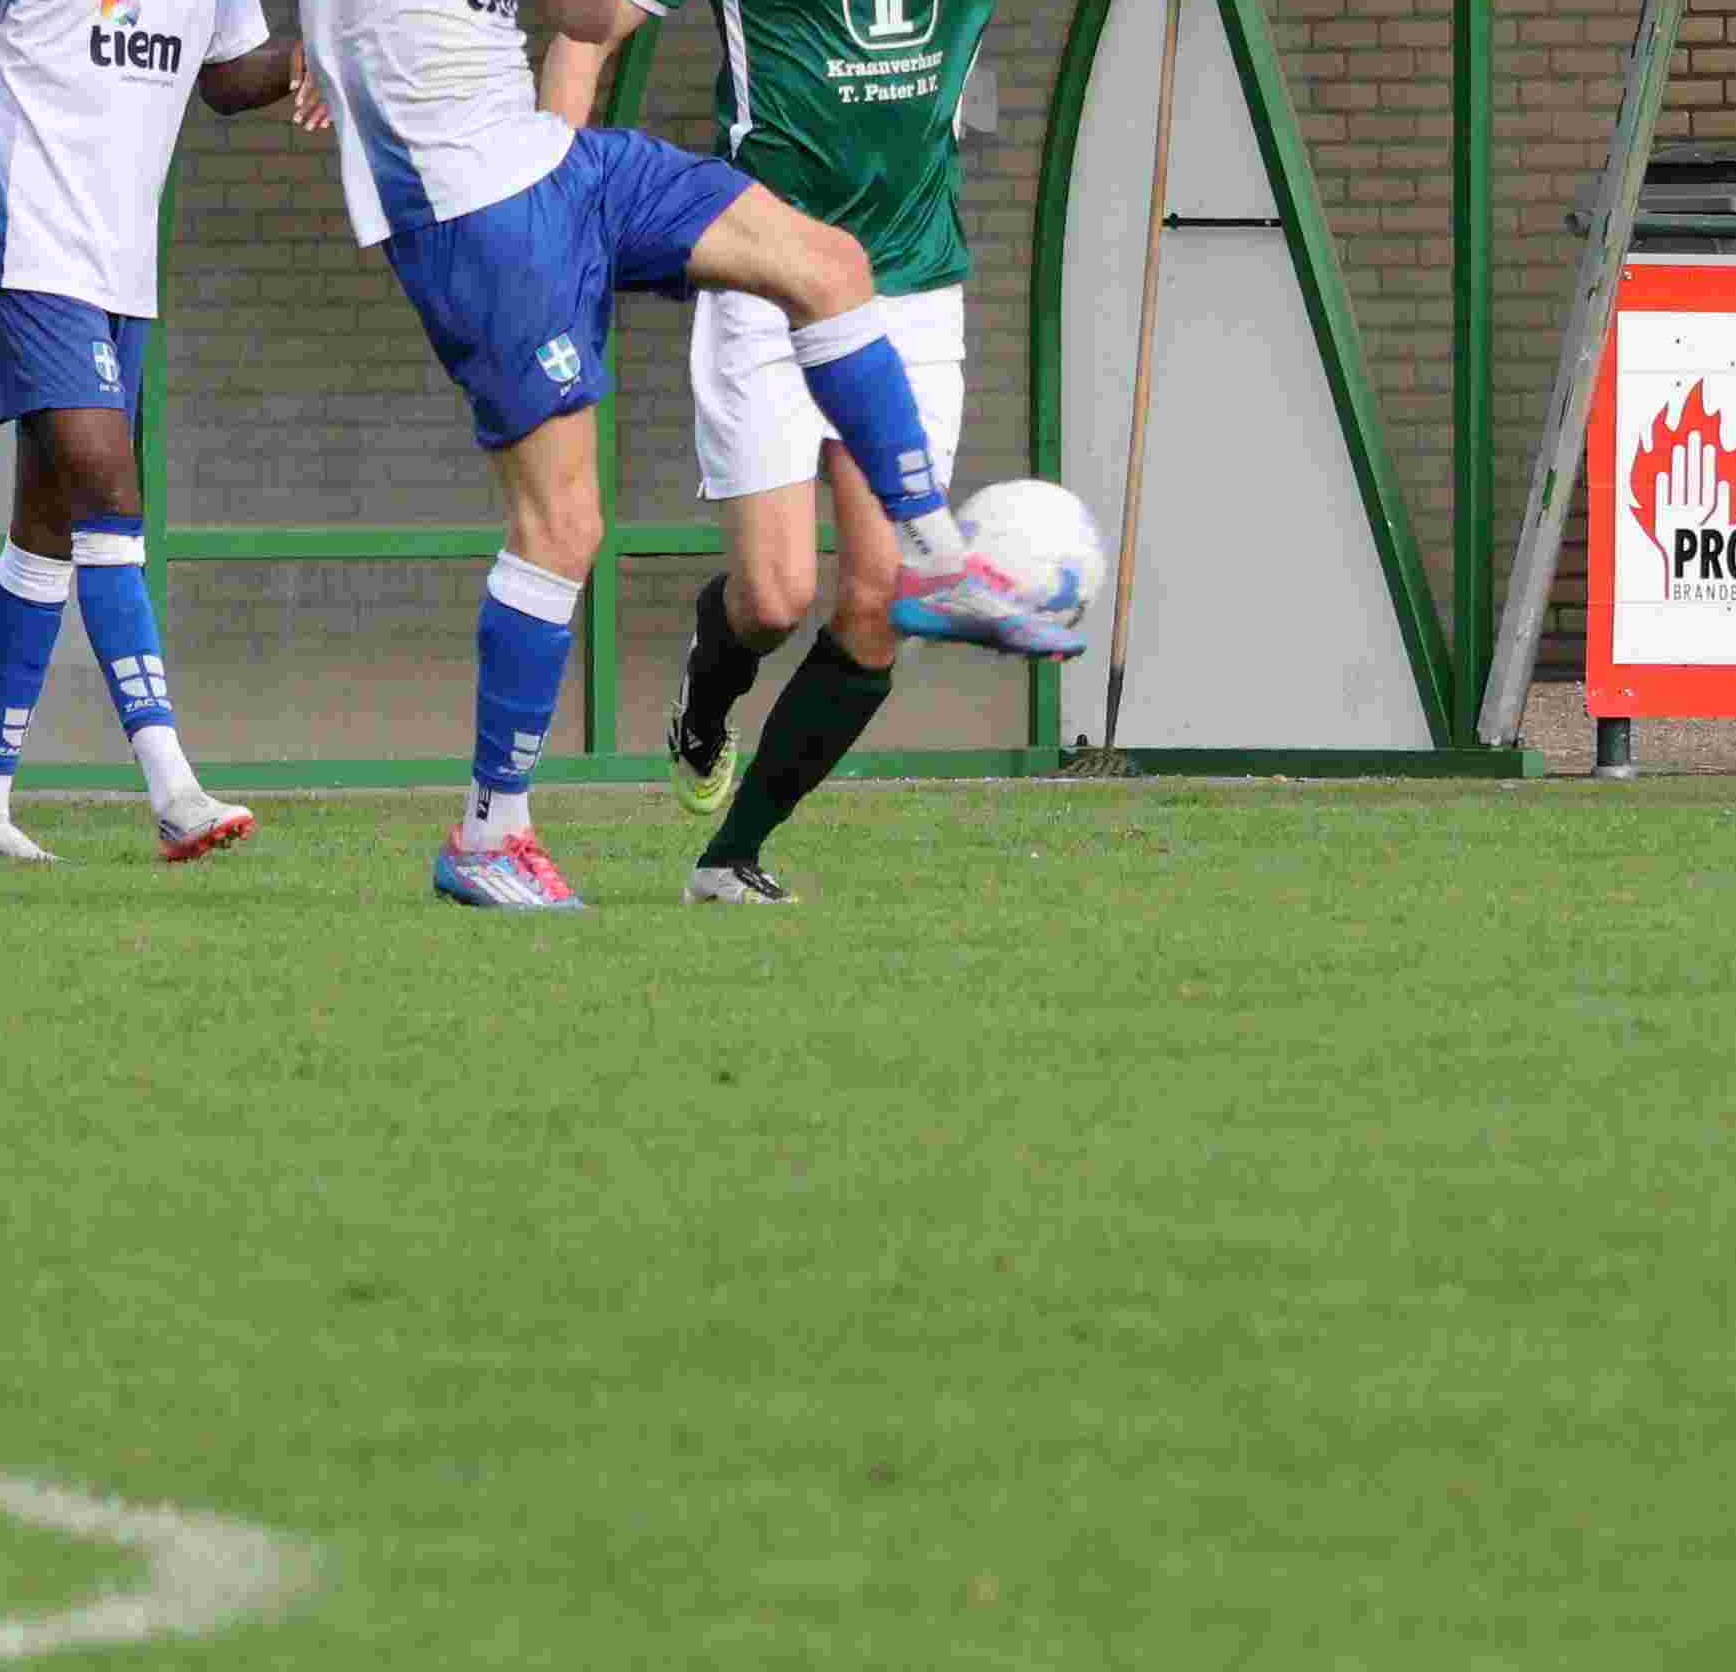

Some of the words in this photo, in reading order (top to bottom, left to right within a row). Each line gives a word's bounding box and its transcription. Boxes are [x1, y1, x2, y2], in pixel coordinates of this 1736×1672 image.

[89, 24, 183, 74] tiem
[840, 83, 860, 103] T.
[863, 78, 916, 102] Pater
